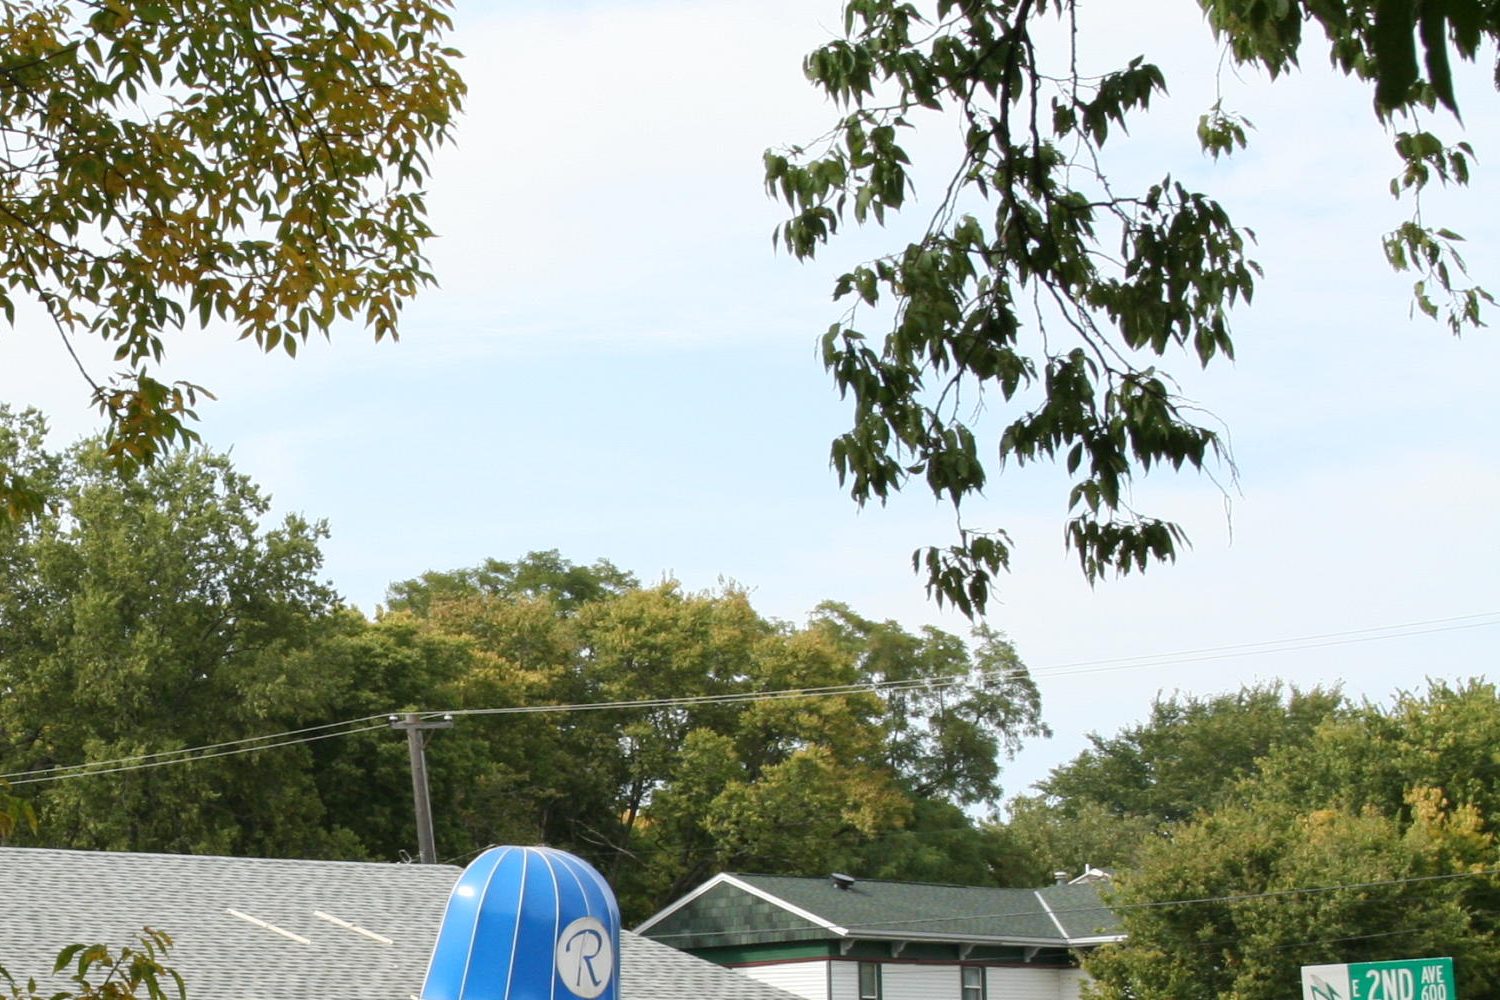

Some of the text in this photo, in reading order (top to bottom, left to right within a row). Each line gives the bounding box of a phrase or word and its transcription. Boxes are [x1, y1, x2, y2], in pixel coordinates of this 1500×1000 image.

[566, 928, 602, 987] R
[1351, 979, 1361, 997] E
[1420, 965, 1445, 984] AVE
